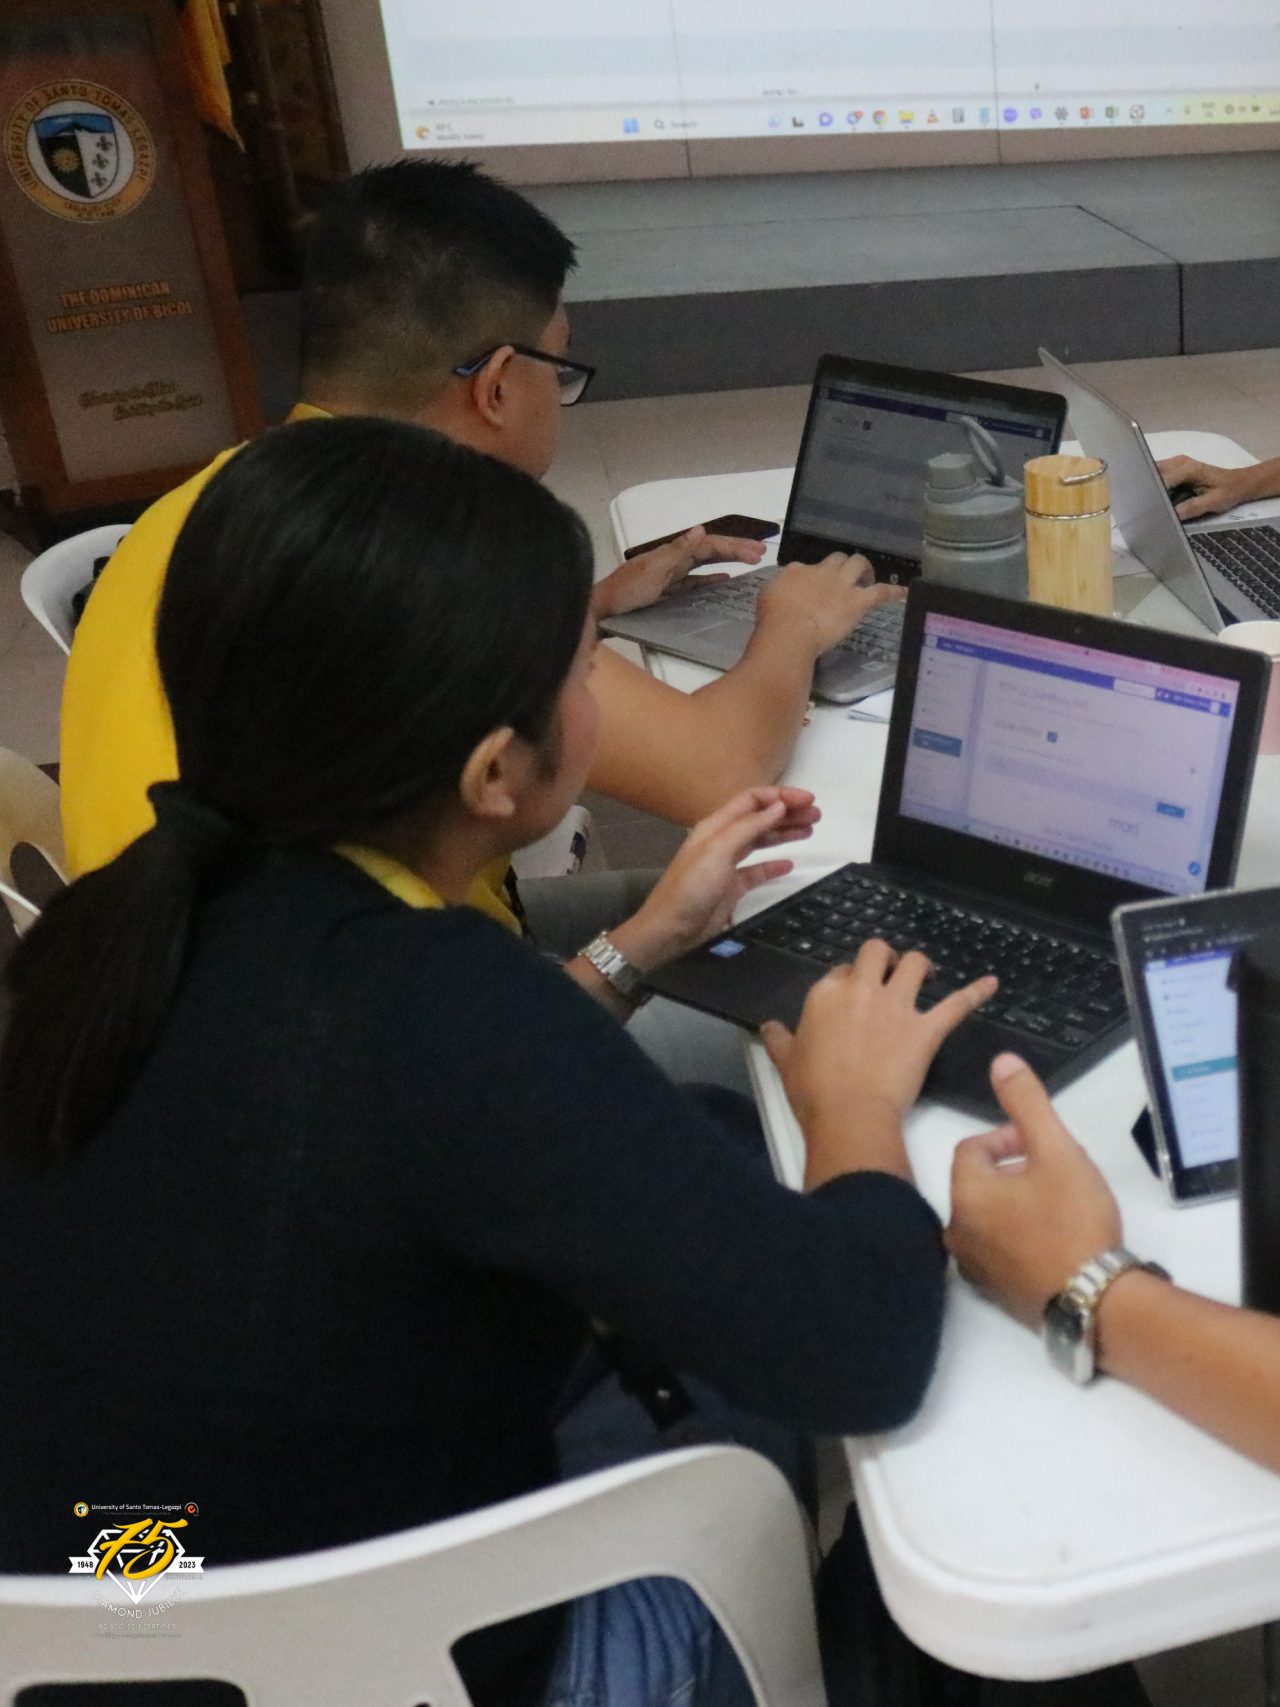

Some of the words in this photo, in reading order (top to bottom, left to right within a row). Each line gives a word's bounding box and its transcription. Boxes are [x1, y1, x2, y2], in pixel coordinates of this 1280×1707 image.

[10, 112, 38, 190] UNIVERSITY
[25, 96, 40, 112] OF
[43, 85, 89, 101] SANTO
[95, 90, 136, 125] TOMAS
[60, 290, 87, 308] THE
[90, 281, 171, 305] DOMINICAN
[48, 308, 130, 333] UNIVERSITY
[133, 305, 151, 321] OF
[152, 300, 193, 319] BICOL
